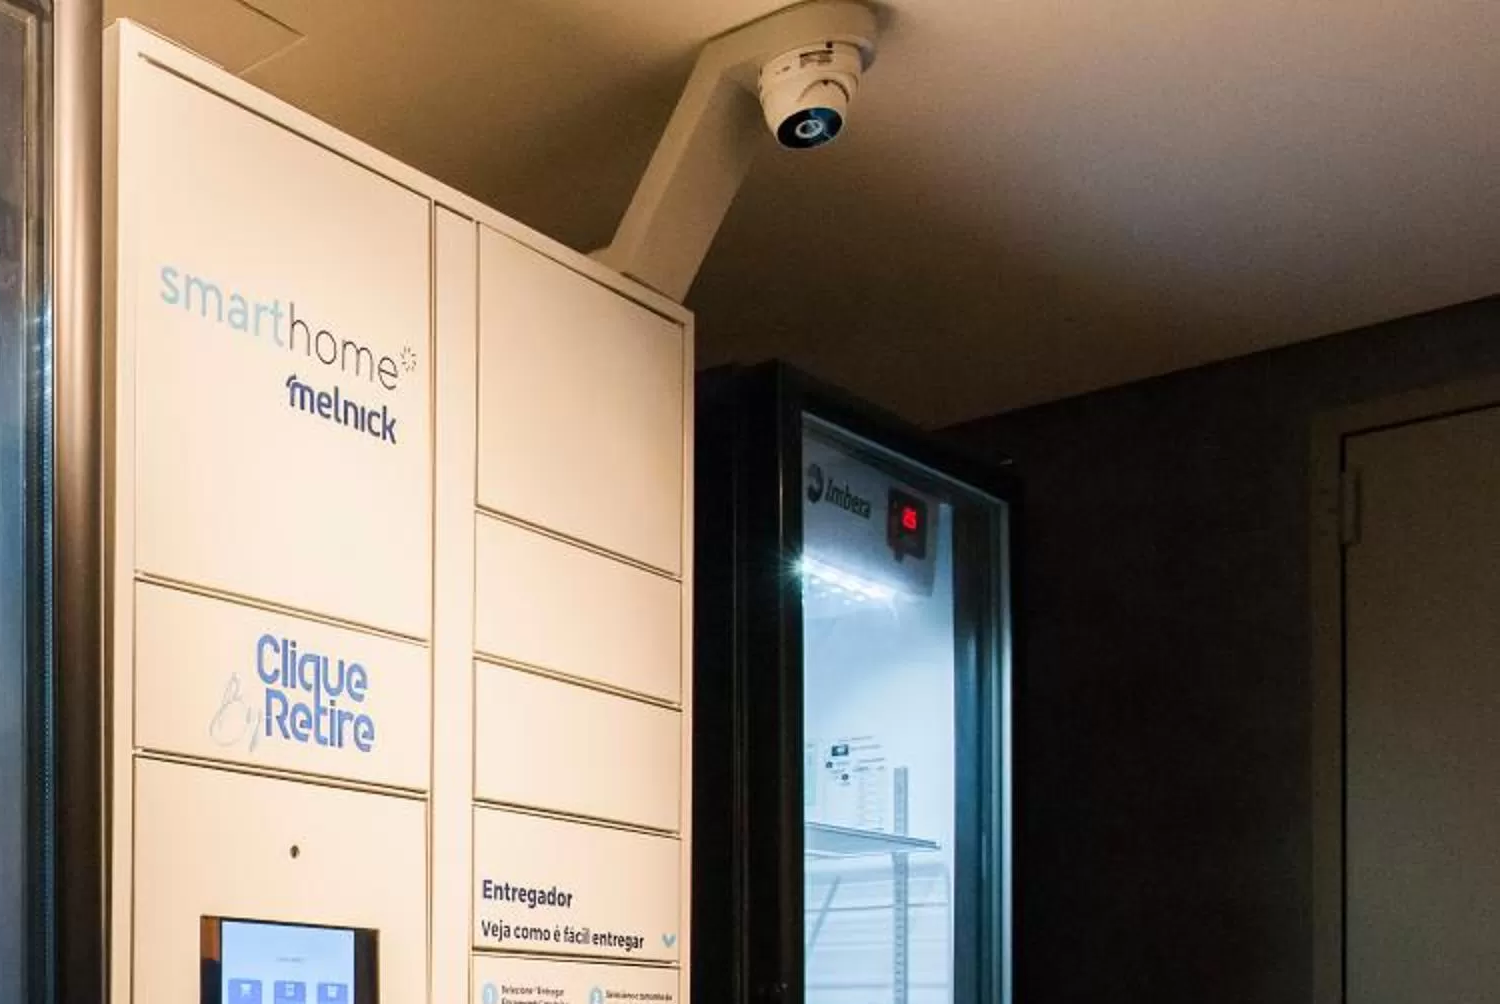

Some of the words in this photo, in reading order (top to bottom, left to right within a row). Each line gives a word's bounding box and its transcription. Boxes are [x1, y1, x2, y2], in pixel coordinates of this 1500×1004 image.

[159, 265, 399, 391] smarthome
[285, 373, 397, 444] melnick
[257, 633, 368, 704] Clique
[265, 687, 375, 752] Retire
[482, 879, 573, 909] Entregador
[481, 920, 511, 942] Veja
[514, 925, 550, 941] como
[553, 925, 560, 942] é
[564, 925, 590, 945] fácil
[592, 931, 644, 952] entregar
